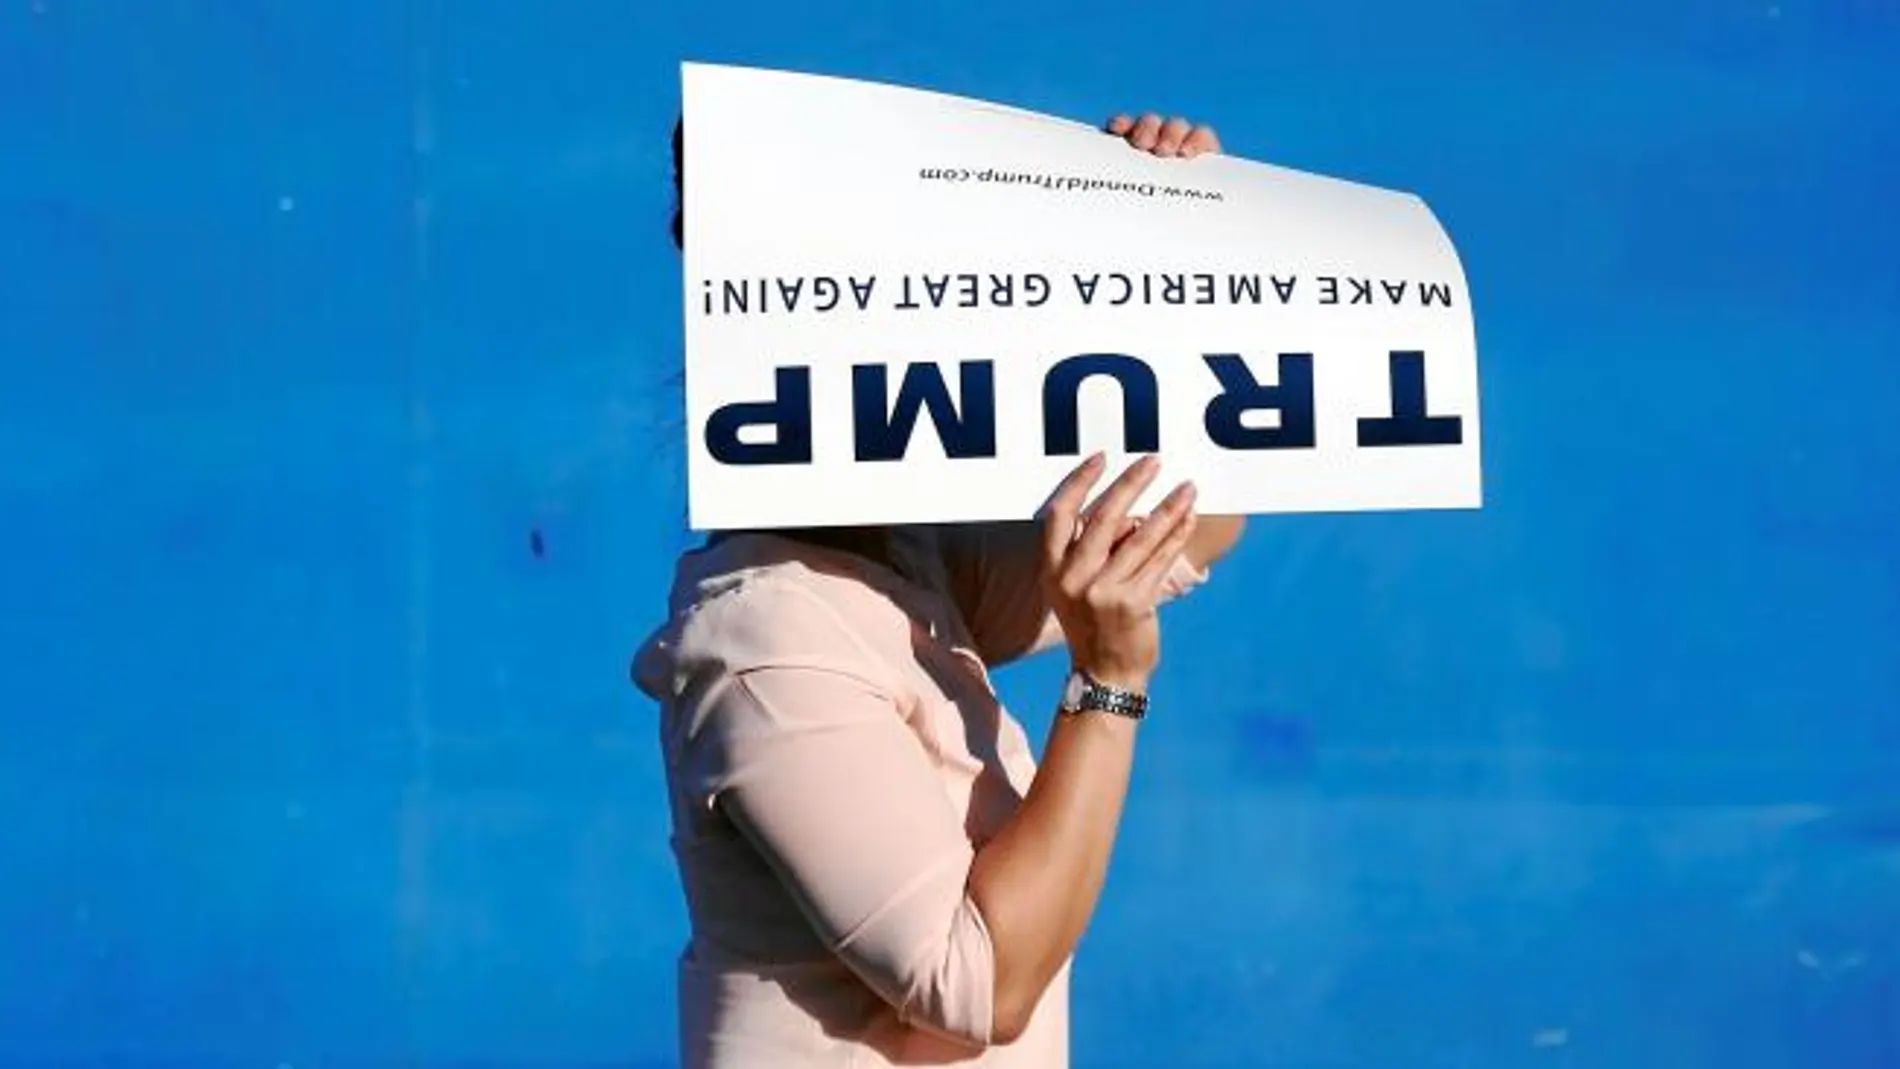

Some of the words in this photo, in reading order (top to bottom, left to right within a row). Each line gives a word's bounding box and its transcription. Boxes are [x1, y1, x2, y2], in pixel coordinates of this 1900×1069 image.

[918, 166, 1223, 202] www.DonaldJTrump.com
[701, 276, 877, 315] AGAIN!
[893, 273, 1051, 309] GREAT
[1073, 272, 1297, 306] AMERICA
[1317, 277, 1453, 309] MAKE
[704, 350, 1463, 466] TRUMP
